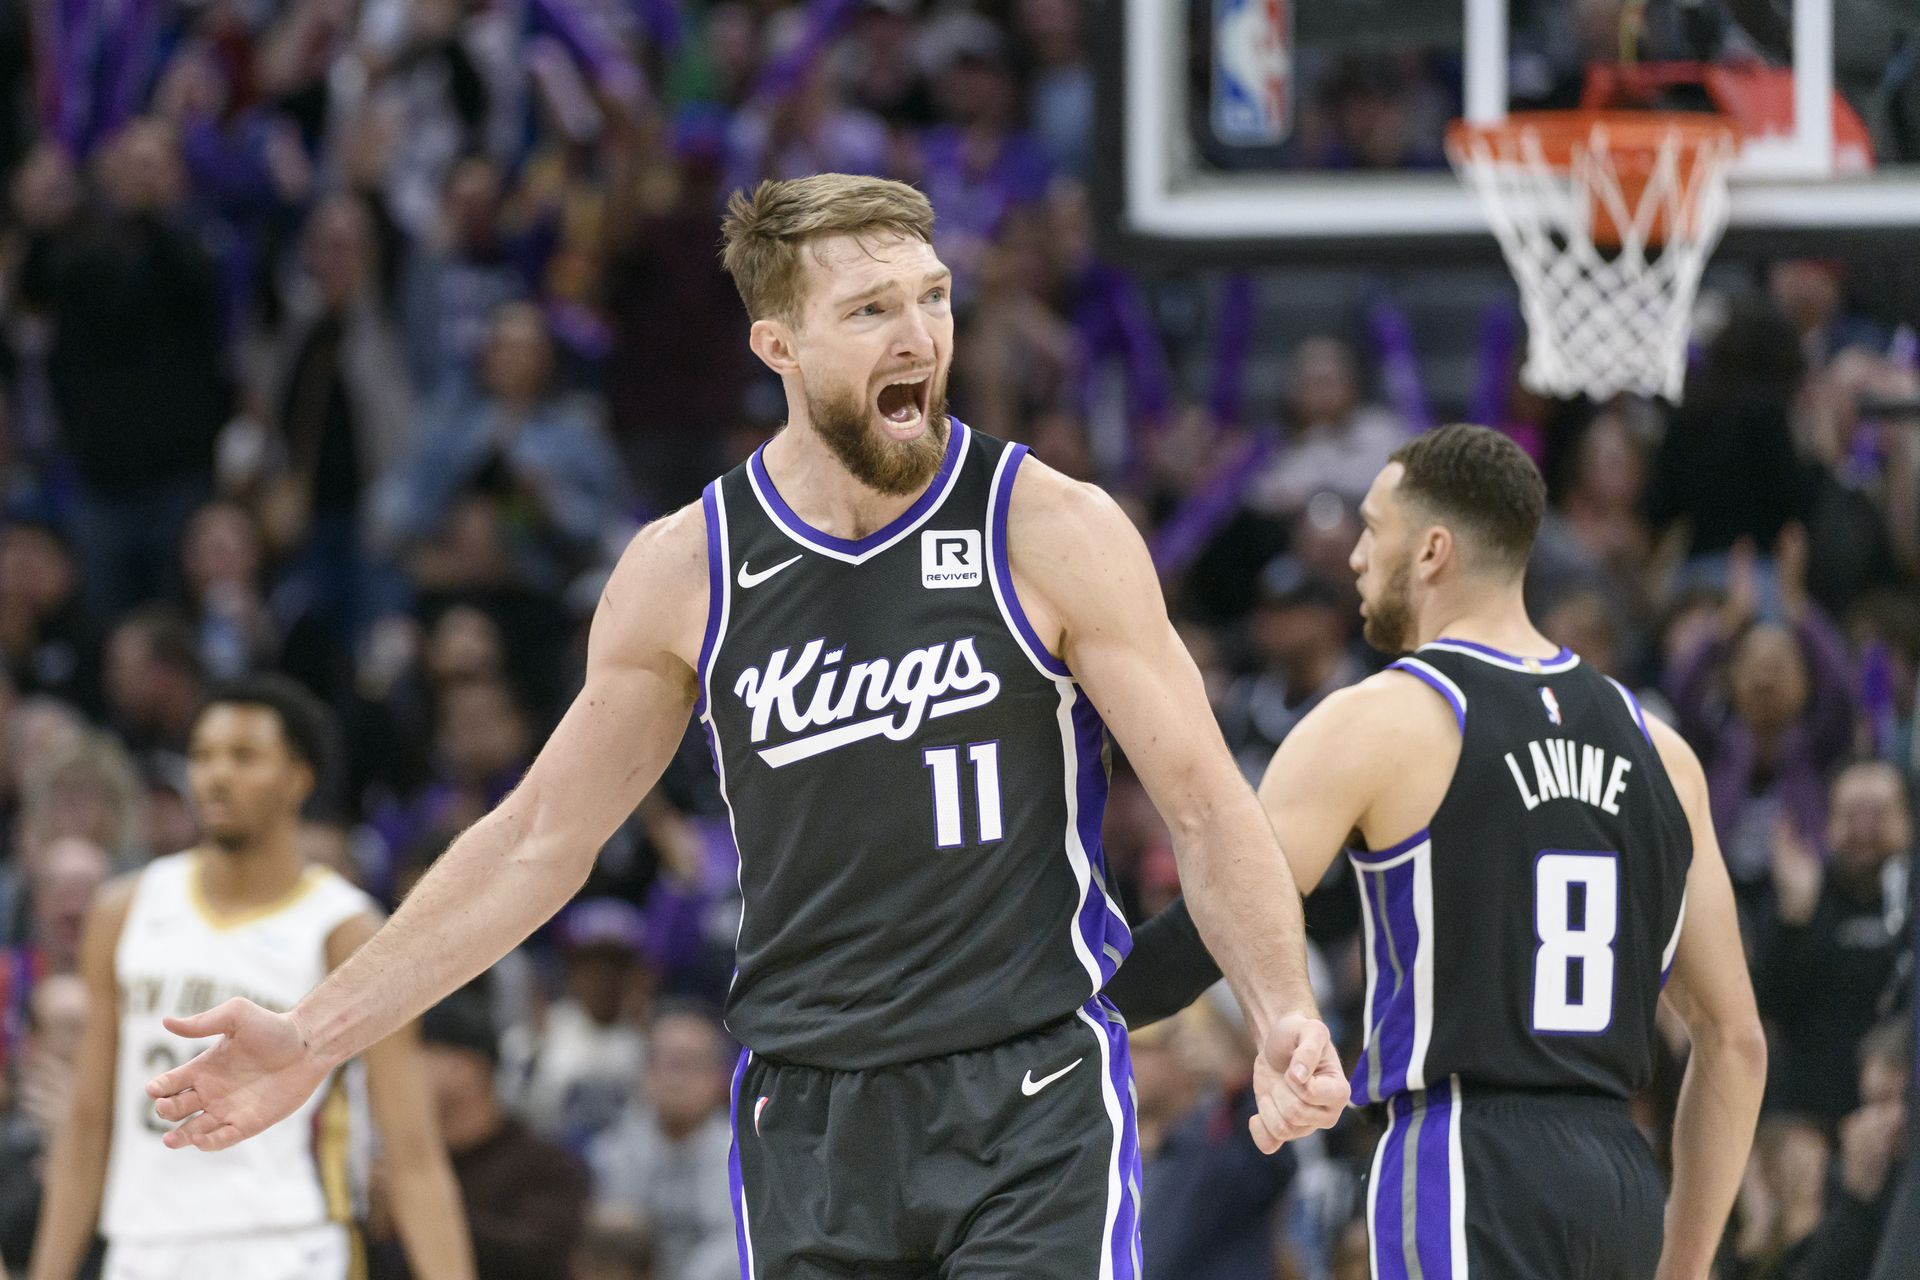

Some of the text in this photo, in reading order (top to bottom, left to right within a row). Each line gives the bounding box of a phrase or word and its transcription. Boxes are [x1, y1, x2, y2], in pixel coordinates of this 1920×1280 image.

[926, 572, 978, 581] REVIVER
[935, 537, 970, 566] R
[733, 636, 1001, 769] Kings
[922, 739, 1005, 849] 11
[1504, 738, 1632, 815] LAVINE
[1530, 849, 1620, 1037] 8
